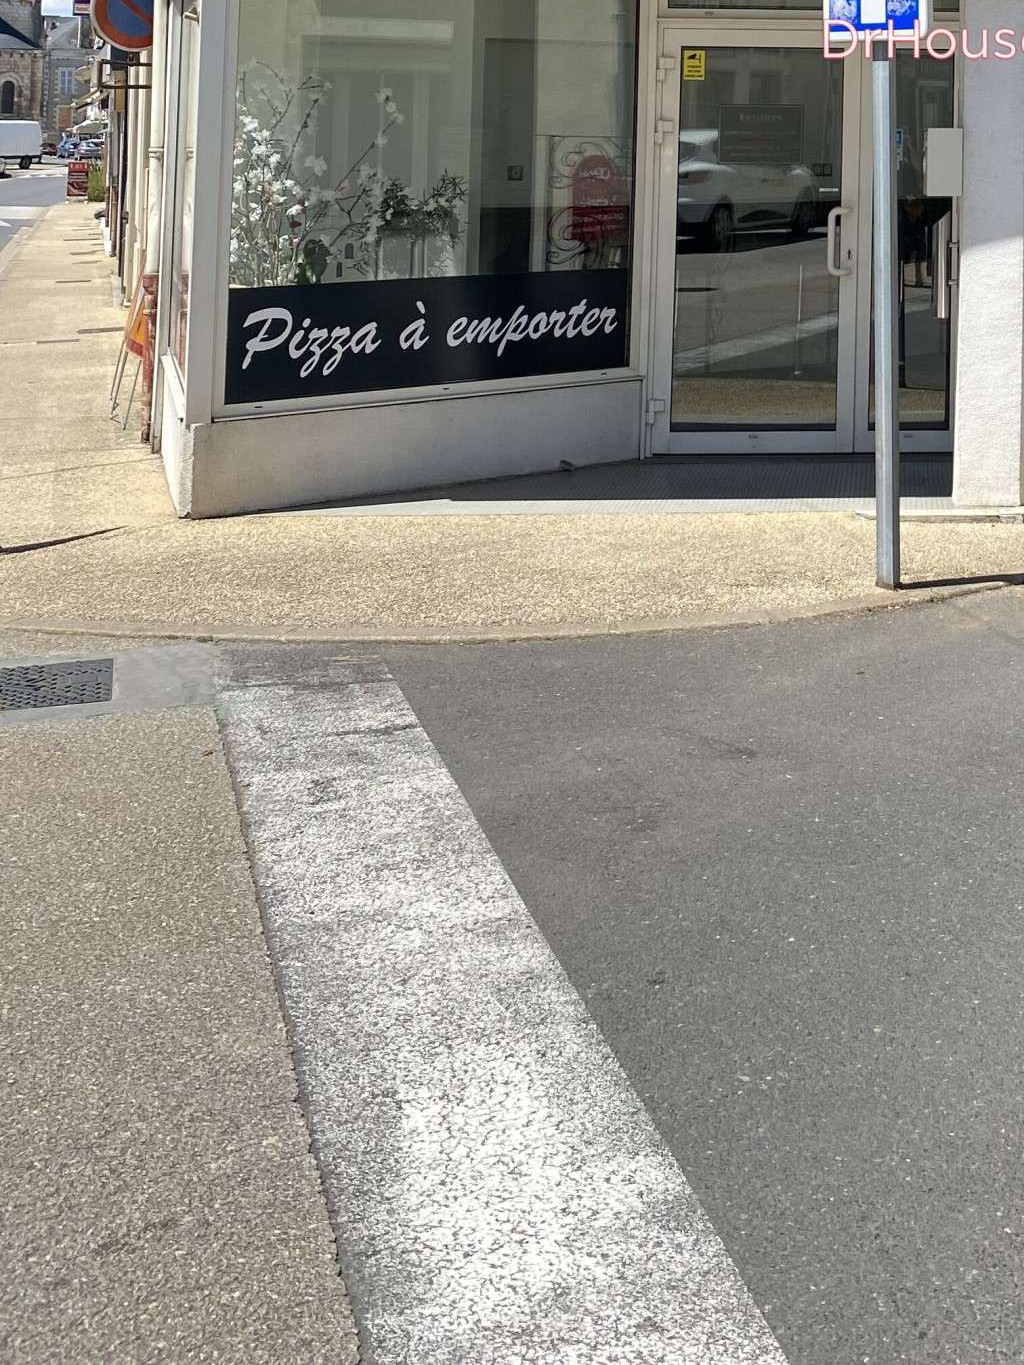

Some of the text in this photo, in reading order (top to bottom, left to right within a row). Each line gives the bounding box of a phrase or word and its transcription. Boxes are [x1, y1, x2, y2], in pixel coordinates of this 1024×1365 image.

[242, 298, 619, 378] Pizza à emporter
